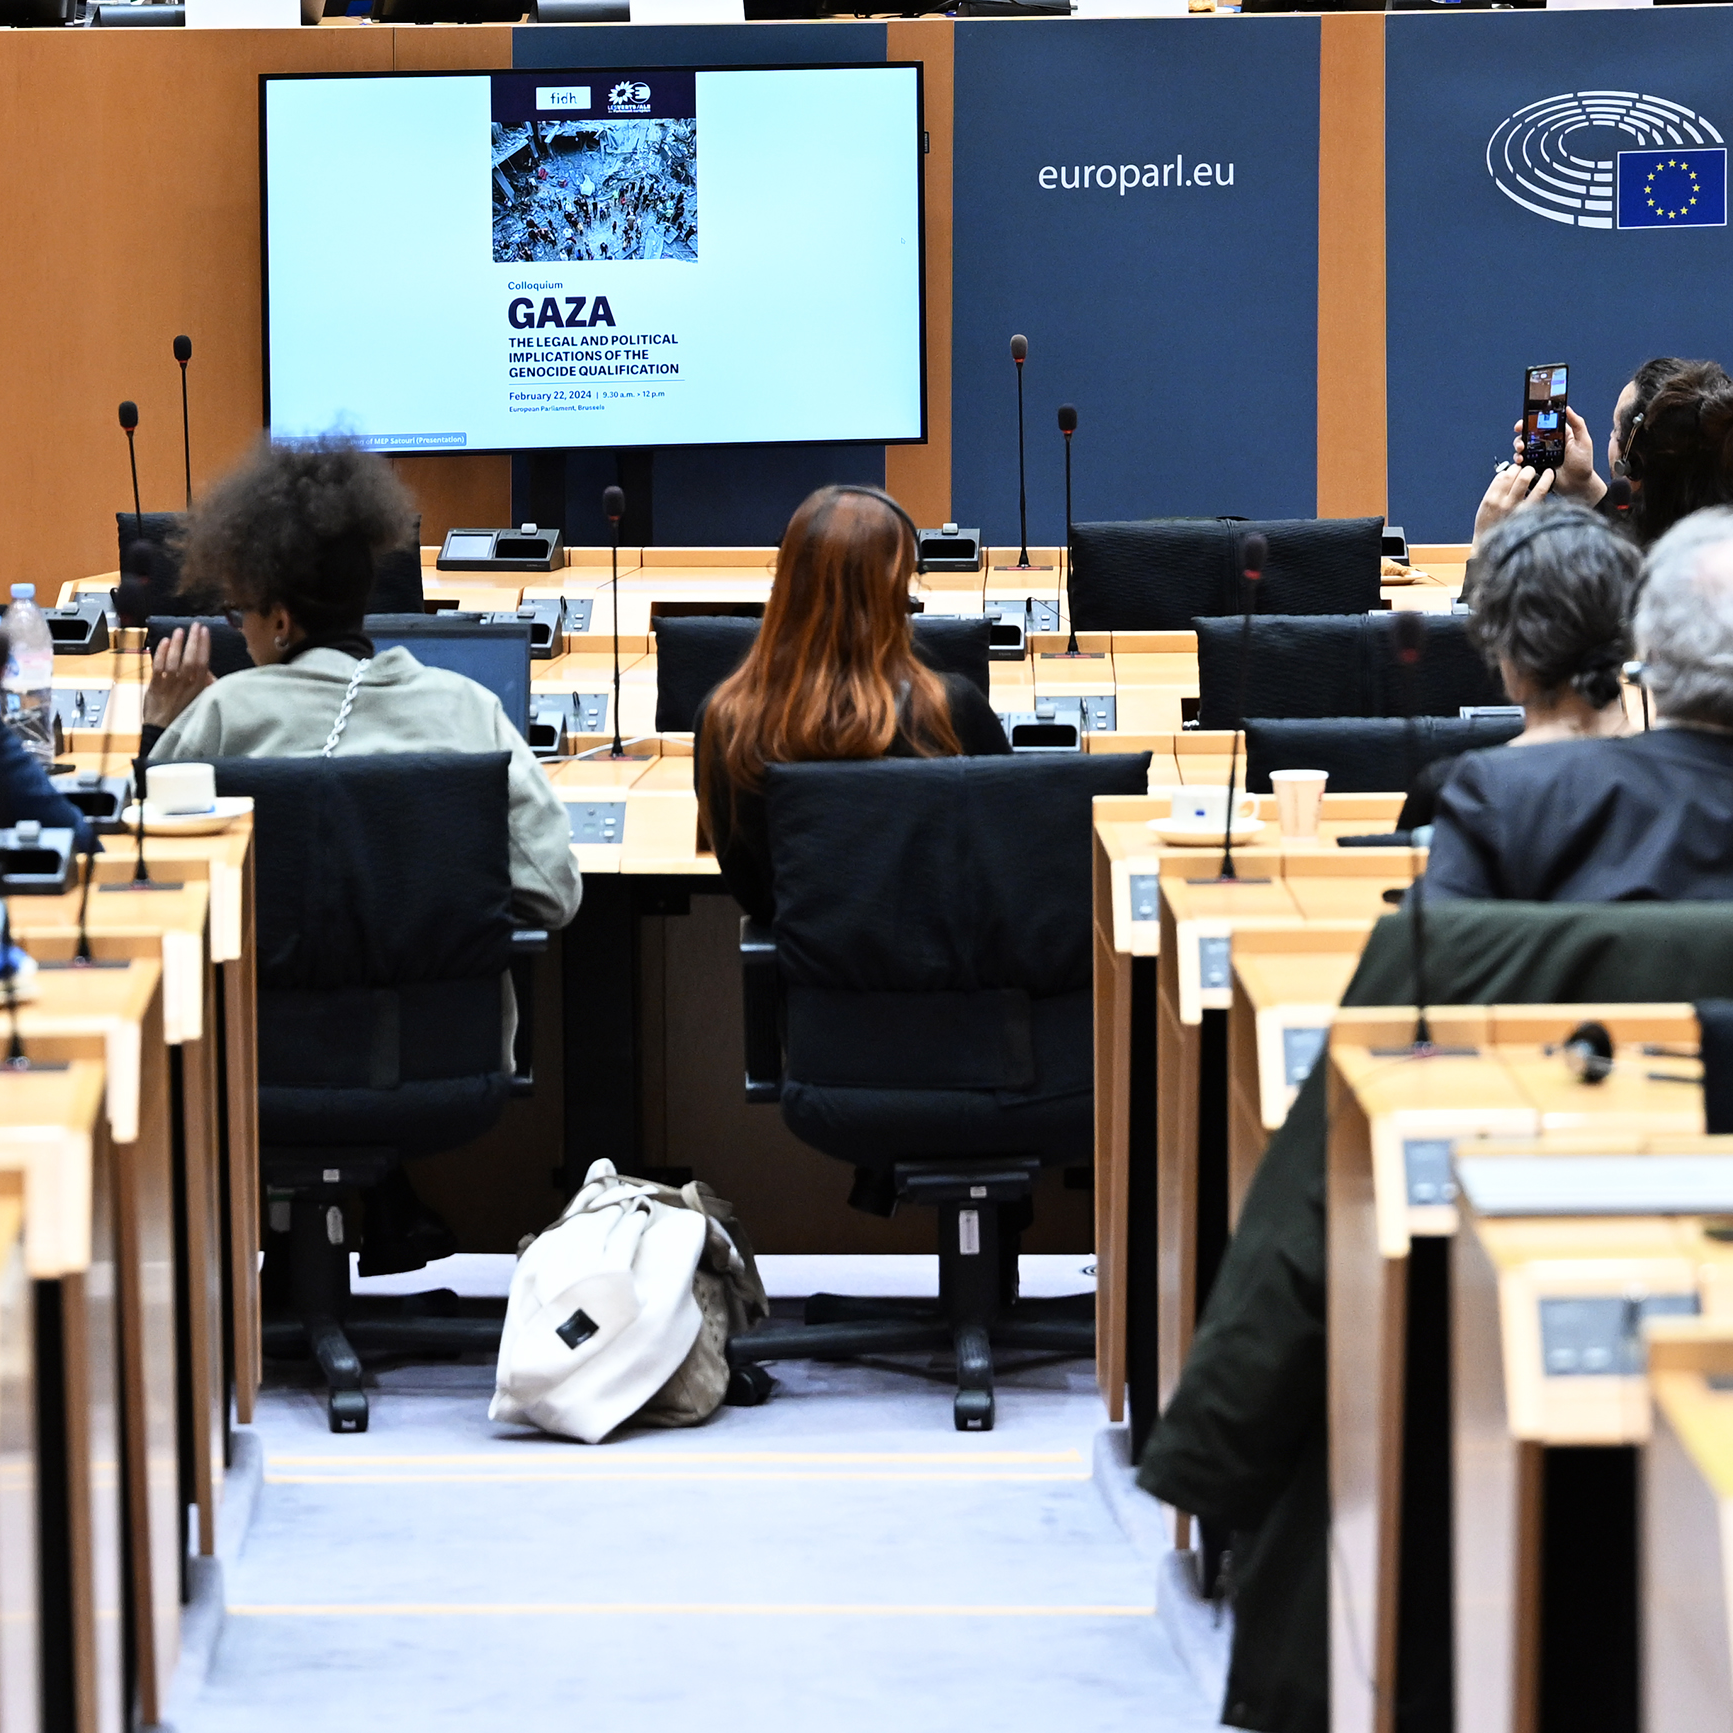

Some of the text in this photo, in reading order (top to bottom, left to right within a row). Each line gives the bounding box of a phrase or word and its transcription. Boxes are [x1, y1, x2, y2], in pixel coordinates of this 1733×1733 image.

[1038, 155, 1235, 196] europarl.eu
[508, 280, 563, 291] Colloquium
[508, 296, 616, 329] GAZA
[509, 334, 678, 348] THE LEGAL AND POLITICAL
[509, 349, 649, 363] IMPLICATIONS OF THE
[509, 364, 679, 378] GENOCIDE QUALIFICATION
[509, 391, 552, 402] February
[553, 391, 567, 400] 22,
[568, 390, 592, 399] 2024
[541, 405, 576, 413] Parliament,
[416, 436, 465, 445] (Presentation)
